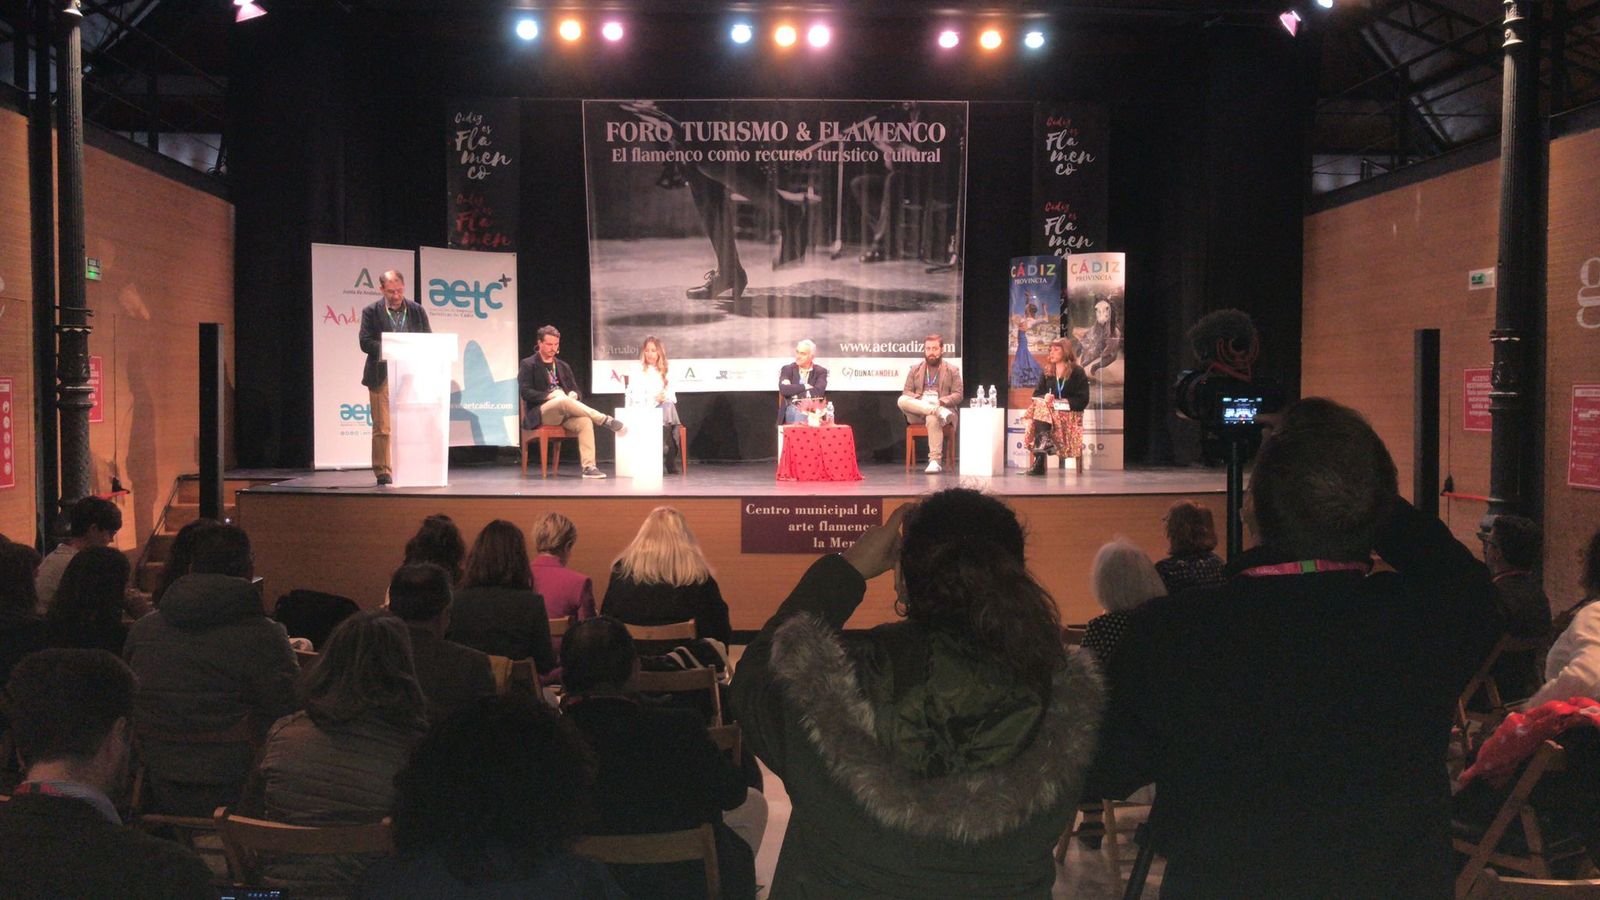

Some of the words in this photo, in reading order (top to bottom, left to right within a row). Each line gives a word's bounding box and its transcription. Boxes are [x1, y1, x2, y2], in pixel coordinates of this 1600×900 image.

[606, 121, 673, 142] FORO
[681, 121, 788, 142] TURISMO
[796, 121, 811, 141] &
[819, 121, 946, 142] FLAMENCO
[612, 148, 627, 162] El
[632, 147, 702, 162] flamenco
[707, 150, 750, 162] como
[755, 150, 812, 162] recurso
[884, 149, 940, 162] cultural
[1014, 277, 1048, 285] PROVINCIA
[1076, 274, 1113, 282] PROVINCIA
[322, 304, 359, 326] And
[840, 341, 956, 353] www.aetcadizm
[745, 503, 790, 516] Centro
[795, 503, 858, 518] municipal
[862, 504, 878, 516] de
[788, 522, 814, 532] arte
[819, 520, 876, 532] flamenc
[813, 536, 825, 548] la
